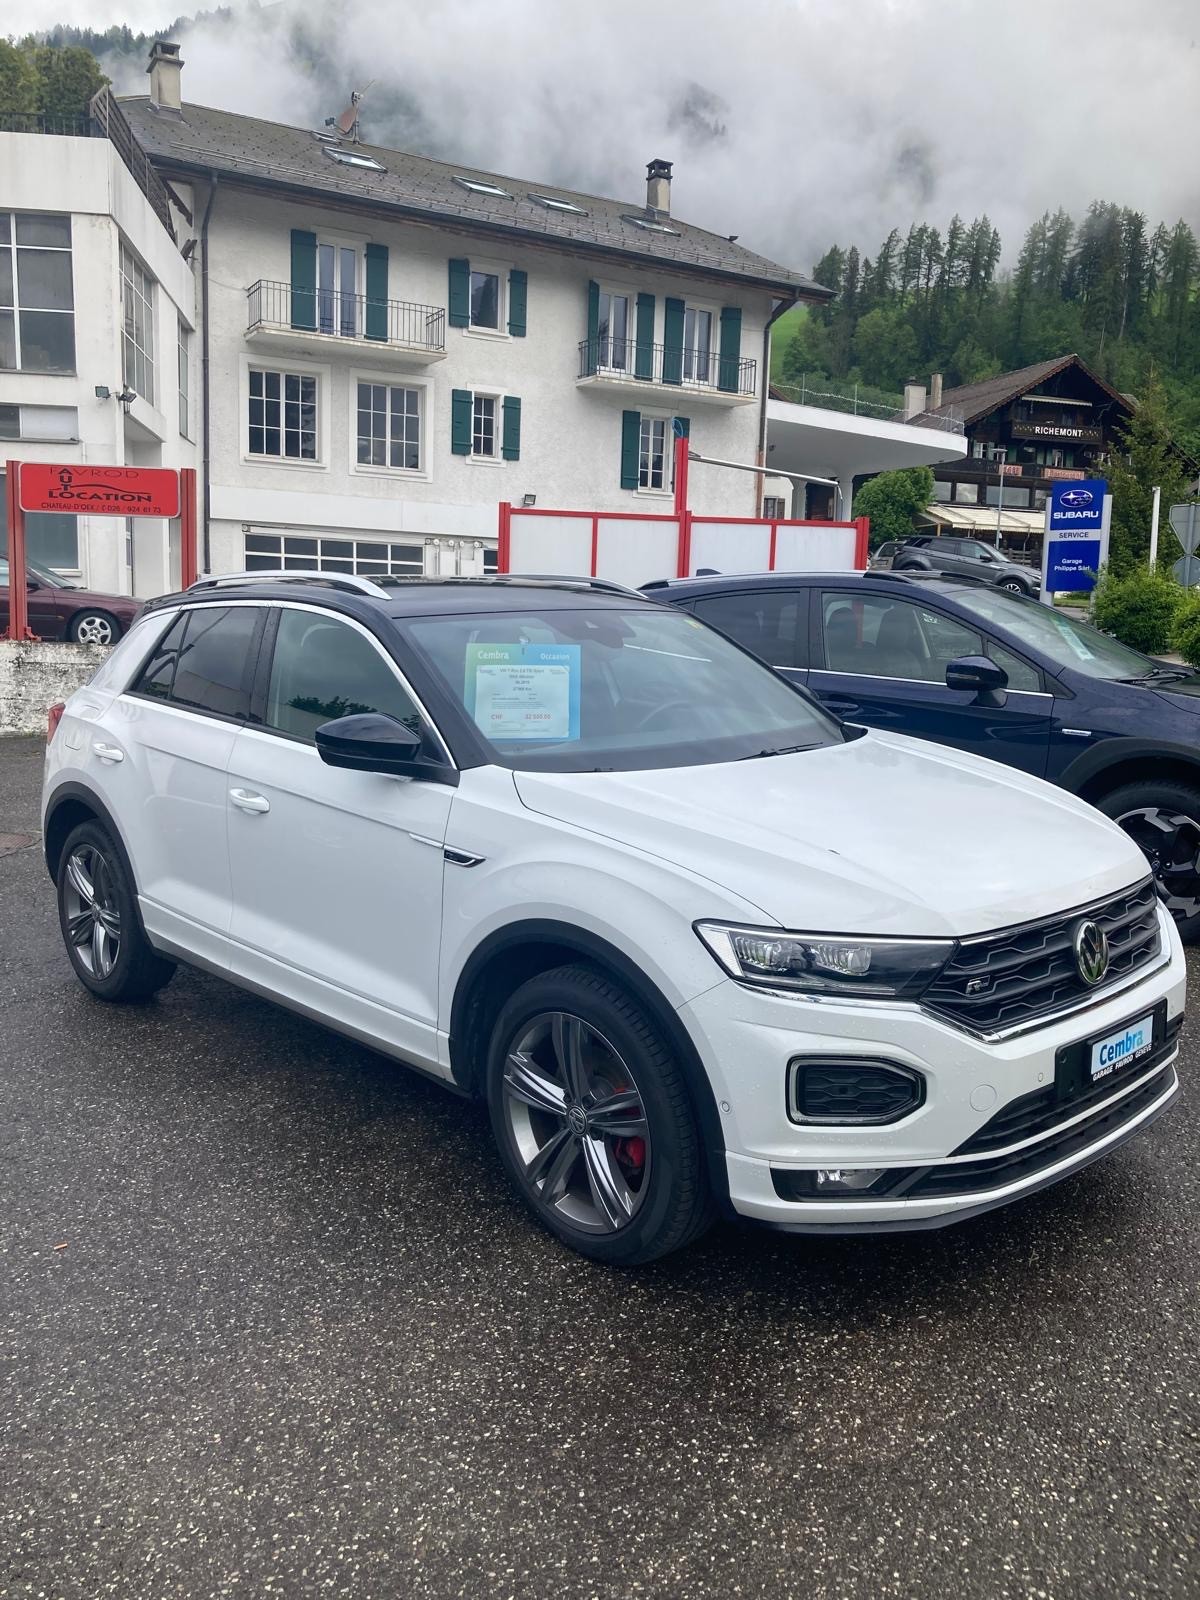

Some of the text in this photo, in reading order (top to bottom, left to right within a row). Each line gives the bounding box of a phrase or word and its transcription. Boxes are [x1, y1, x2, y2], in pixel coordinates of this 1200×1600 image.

[1034, 426, 1083, 437] RICHEMONT
[48, 490, 152, 502] LOCATION
[1053, 510, 1099, 519] SUBARU
[1061, 558, 1083, 566] Garage
[478, 650, 509, 660] Cembra
[540, 651, 570, 661] Occasion
[1099, 1030, 1144, 1066] Cembra
[1092, 1064, 1114, 1082] GARAGE
[1115, 1054, 1134, 1070] FAVROD
